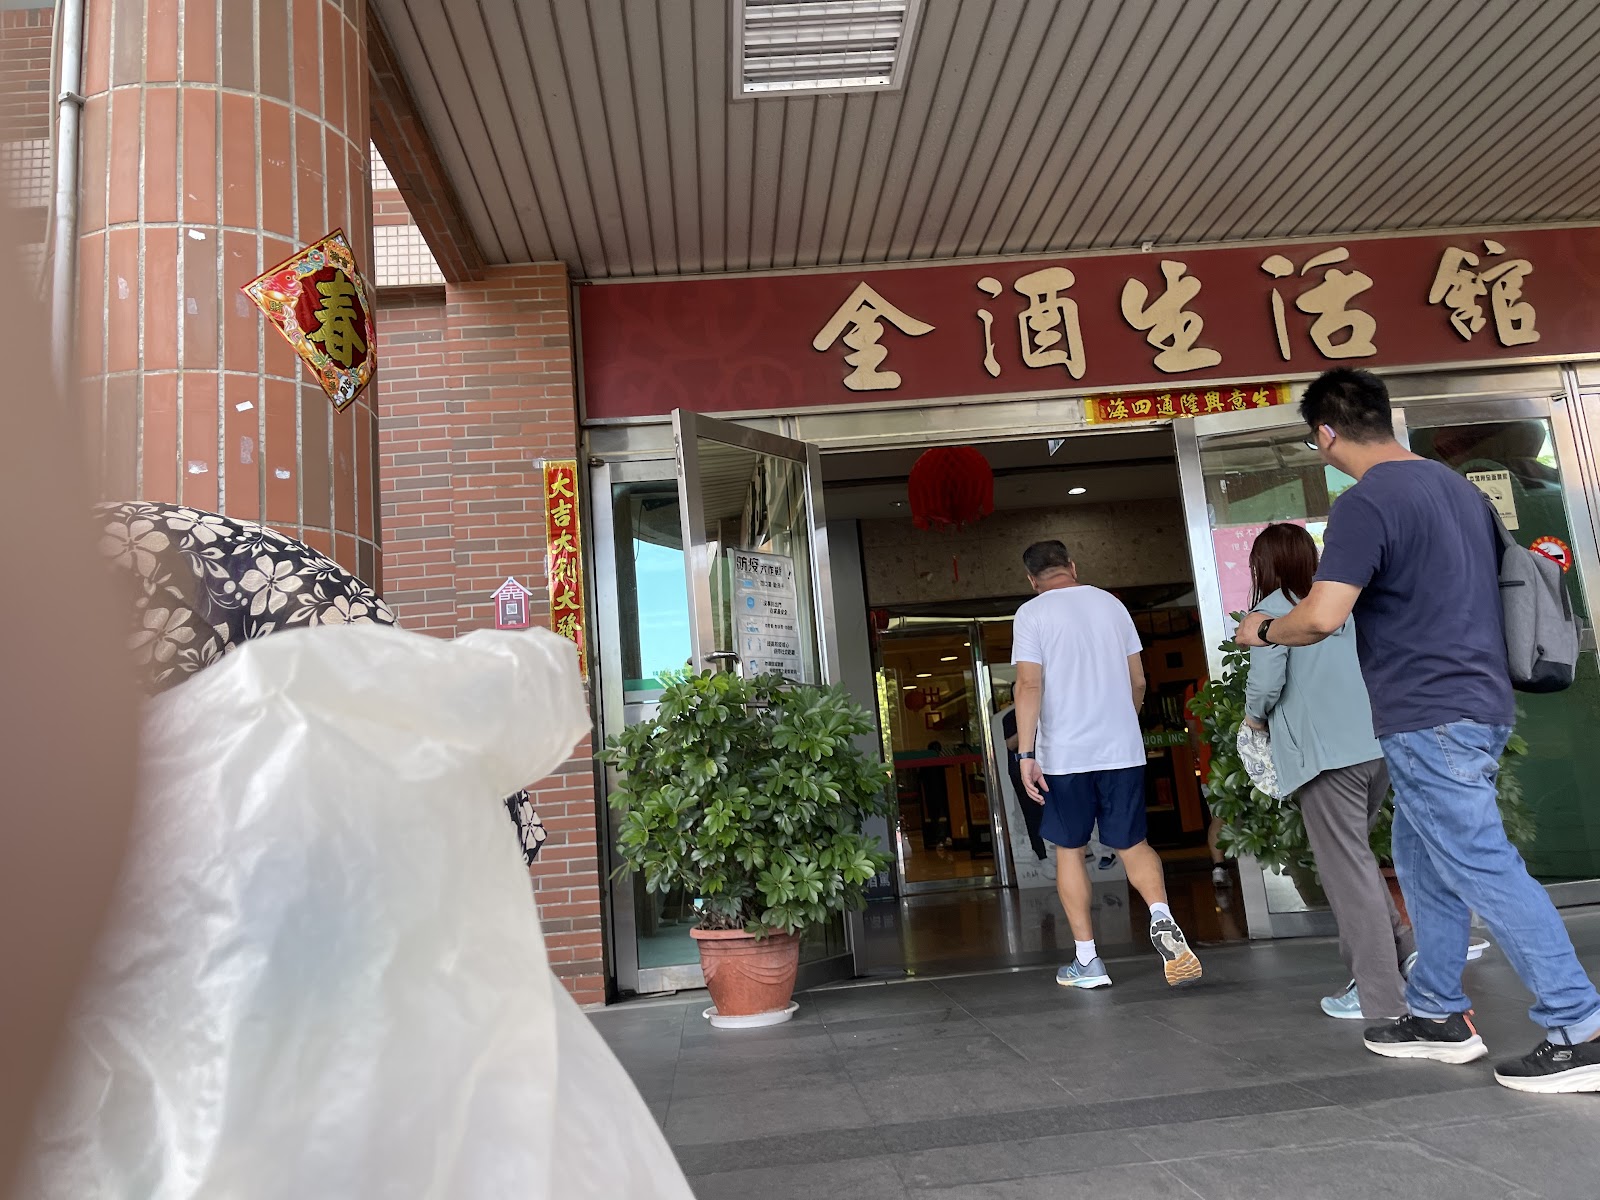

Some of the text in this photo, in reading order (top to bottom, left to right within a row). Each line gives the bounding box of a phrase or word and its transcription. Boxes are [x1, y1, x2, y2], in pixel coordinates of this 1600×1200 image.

[305, 270, 366, 368] 春
[812, 240, 1541, 392] 金酒生活館
[549, 472, 582, 660] 大吉大利大發
